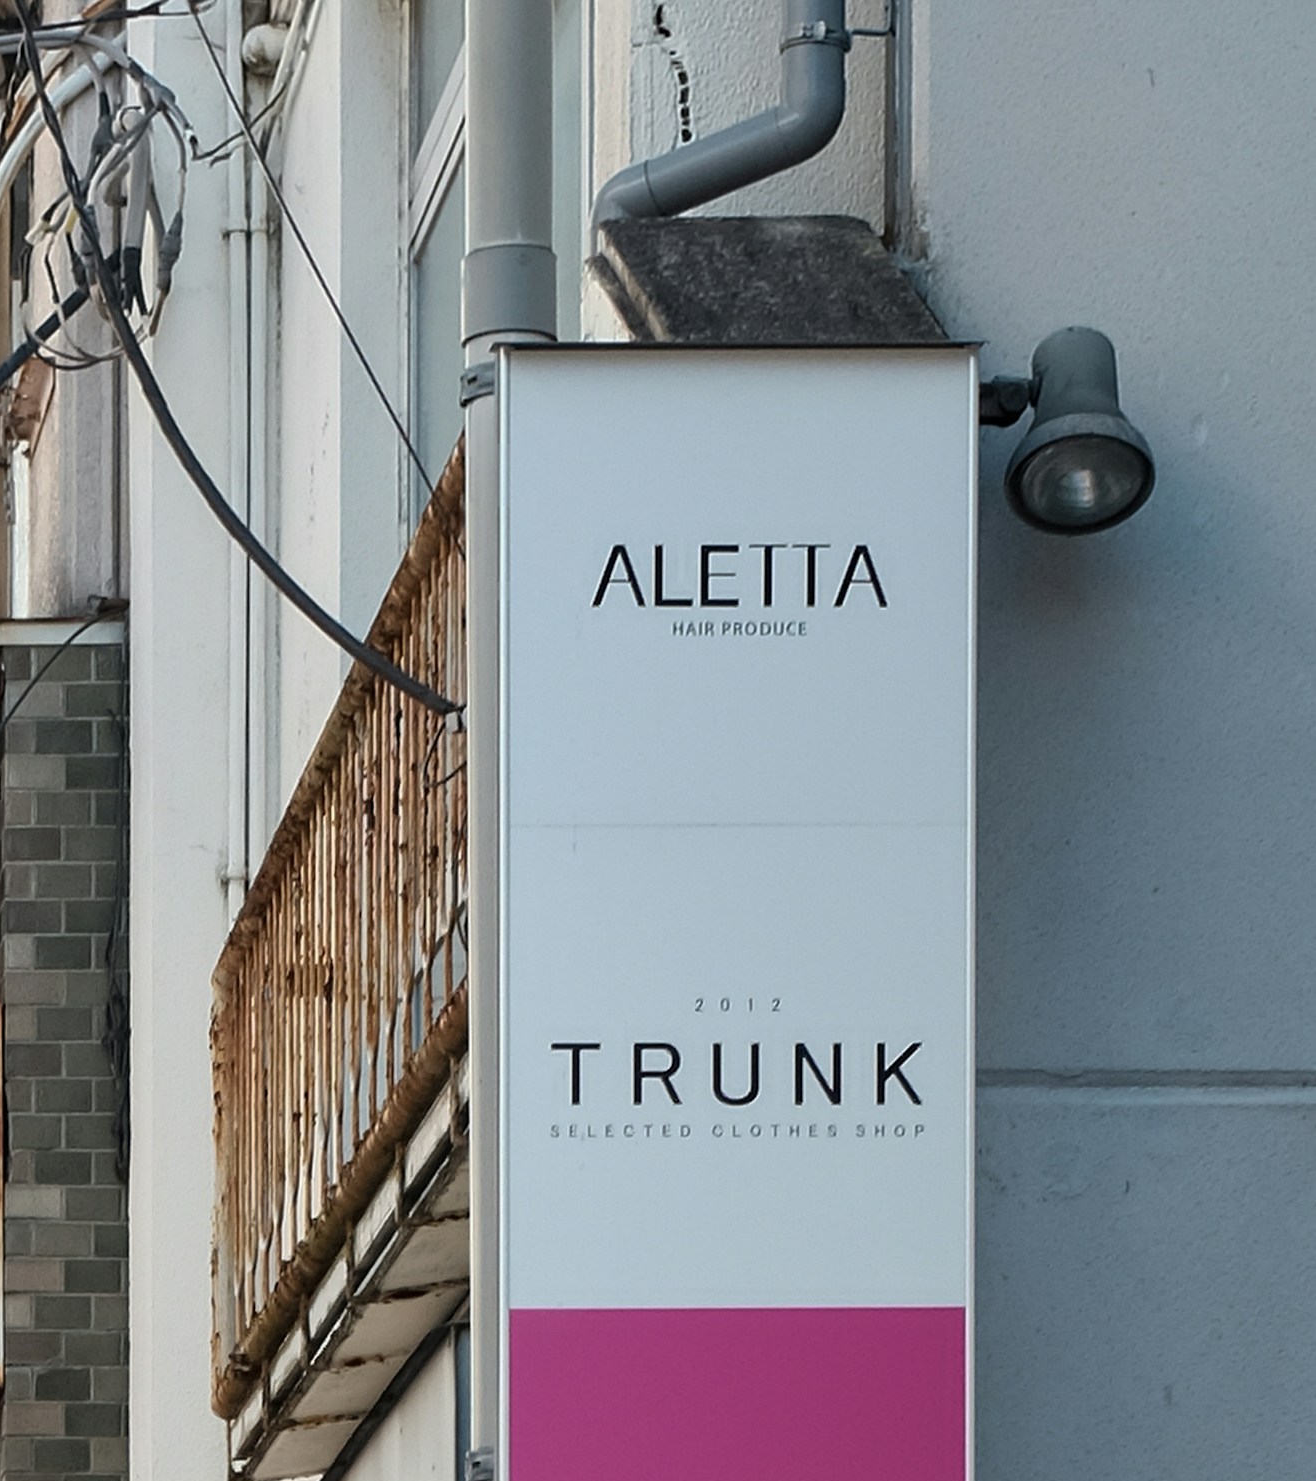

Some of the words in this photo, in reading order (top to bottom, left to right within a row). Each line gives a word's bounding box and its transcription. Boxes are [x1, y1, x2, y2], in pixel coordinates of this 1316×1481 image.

[591, 543, 890, 608] ALETTA
[672, 620, 717, 637] HAIR
[721, 620, 808, 637] PRODUCE
[695, 997, 783, 1013] 2012
[551, 1042, 924, 1106] TRUNK
[550, 1125, 693, 1139] SELECTED
[712, 1125, 838, 1139] CLOTHES
[856, 1125, 927, 1139] SHOP
